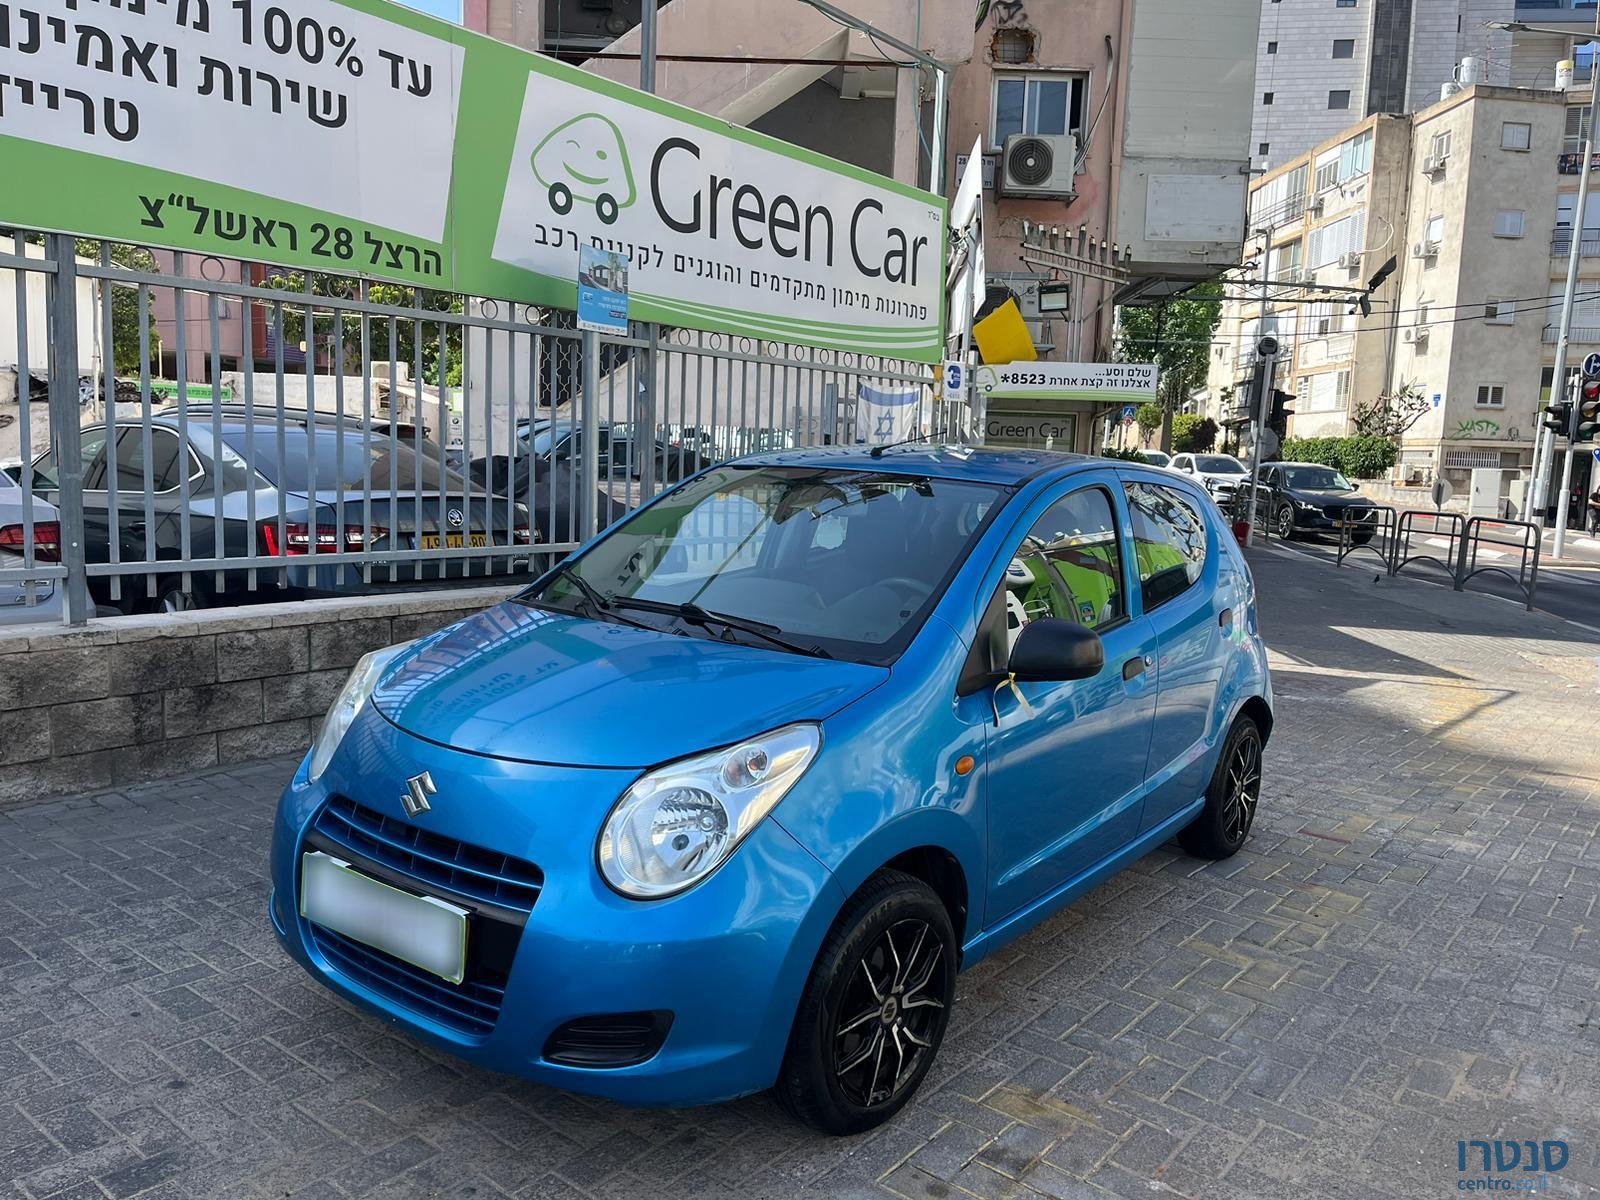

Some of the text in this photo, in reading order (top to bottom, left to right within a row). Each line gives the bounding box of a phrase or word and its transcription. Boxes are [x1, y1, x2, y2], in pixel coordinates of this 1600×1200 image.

[232, 0, 364, 78] 100%
[379, 49, 432, 98] עד
[198, 56, 348, 129] שירות
[650, 136, 928, 287] Green Car
[311, 223, 354, 260] 28
[534, 223, 579, 251] רכב
[364, 230, 442, 277] הרצל
[674, 254, 742, 284] והוגנים
[750, 270, 826, 300] מתקדמים
[832, 287, 870, 309] מימון
[875, 296, 928, 321] פתרונות
[1049, 377, 1077, 387] אחרת
[1081, 378, 1103, 389] קצת
[1106, 379, 1118, 388] זה
[1122, 377, 1151, 388] אצלנו
[1128, 367, 1152, 378] שלם
[987, 421, 1067, 439] Green Car
